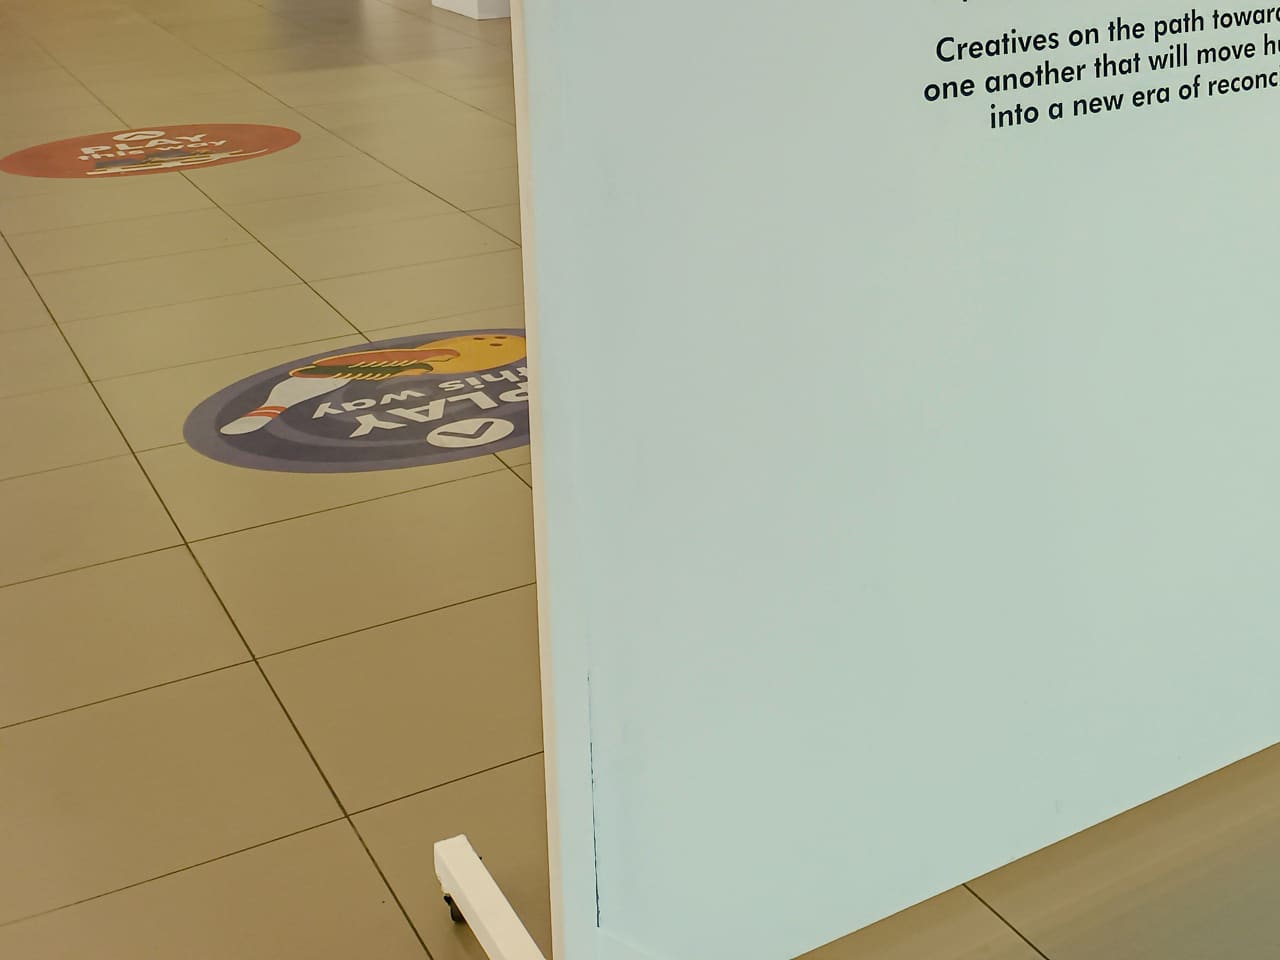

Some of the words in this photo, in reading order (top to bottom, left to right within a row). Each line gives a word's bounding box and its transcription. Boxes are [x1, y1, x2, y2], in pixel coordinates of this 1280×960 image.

[936, 28, 1060, 63] Creatives
[1068, 27, 1099, 47] on
[1107, 16, 1145, 42] the
[1154, 8, 1204, 43] path
[923, 78, 975, 102] one
[985, 60, 1087, 94] another
[1093, 52, 1141, 79] that
[1148, 42, 1188, 71] will
[1197, 42, 1256, 65] move
[990, 103, 1039, 129] into
[1048, 102, 1063, 120] a
[1073, 93, 1124, 117] new
[1132, 87, 1170, 108] era
[1178, 74, 1201, 100] of
[81, 134, 208, 155] PLAY
[157, 140, 227, 152] way
[312, 390, 426, 419] way
